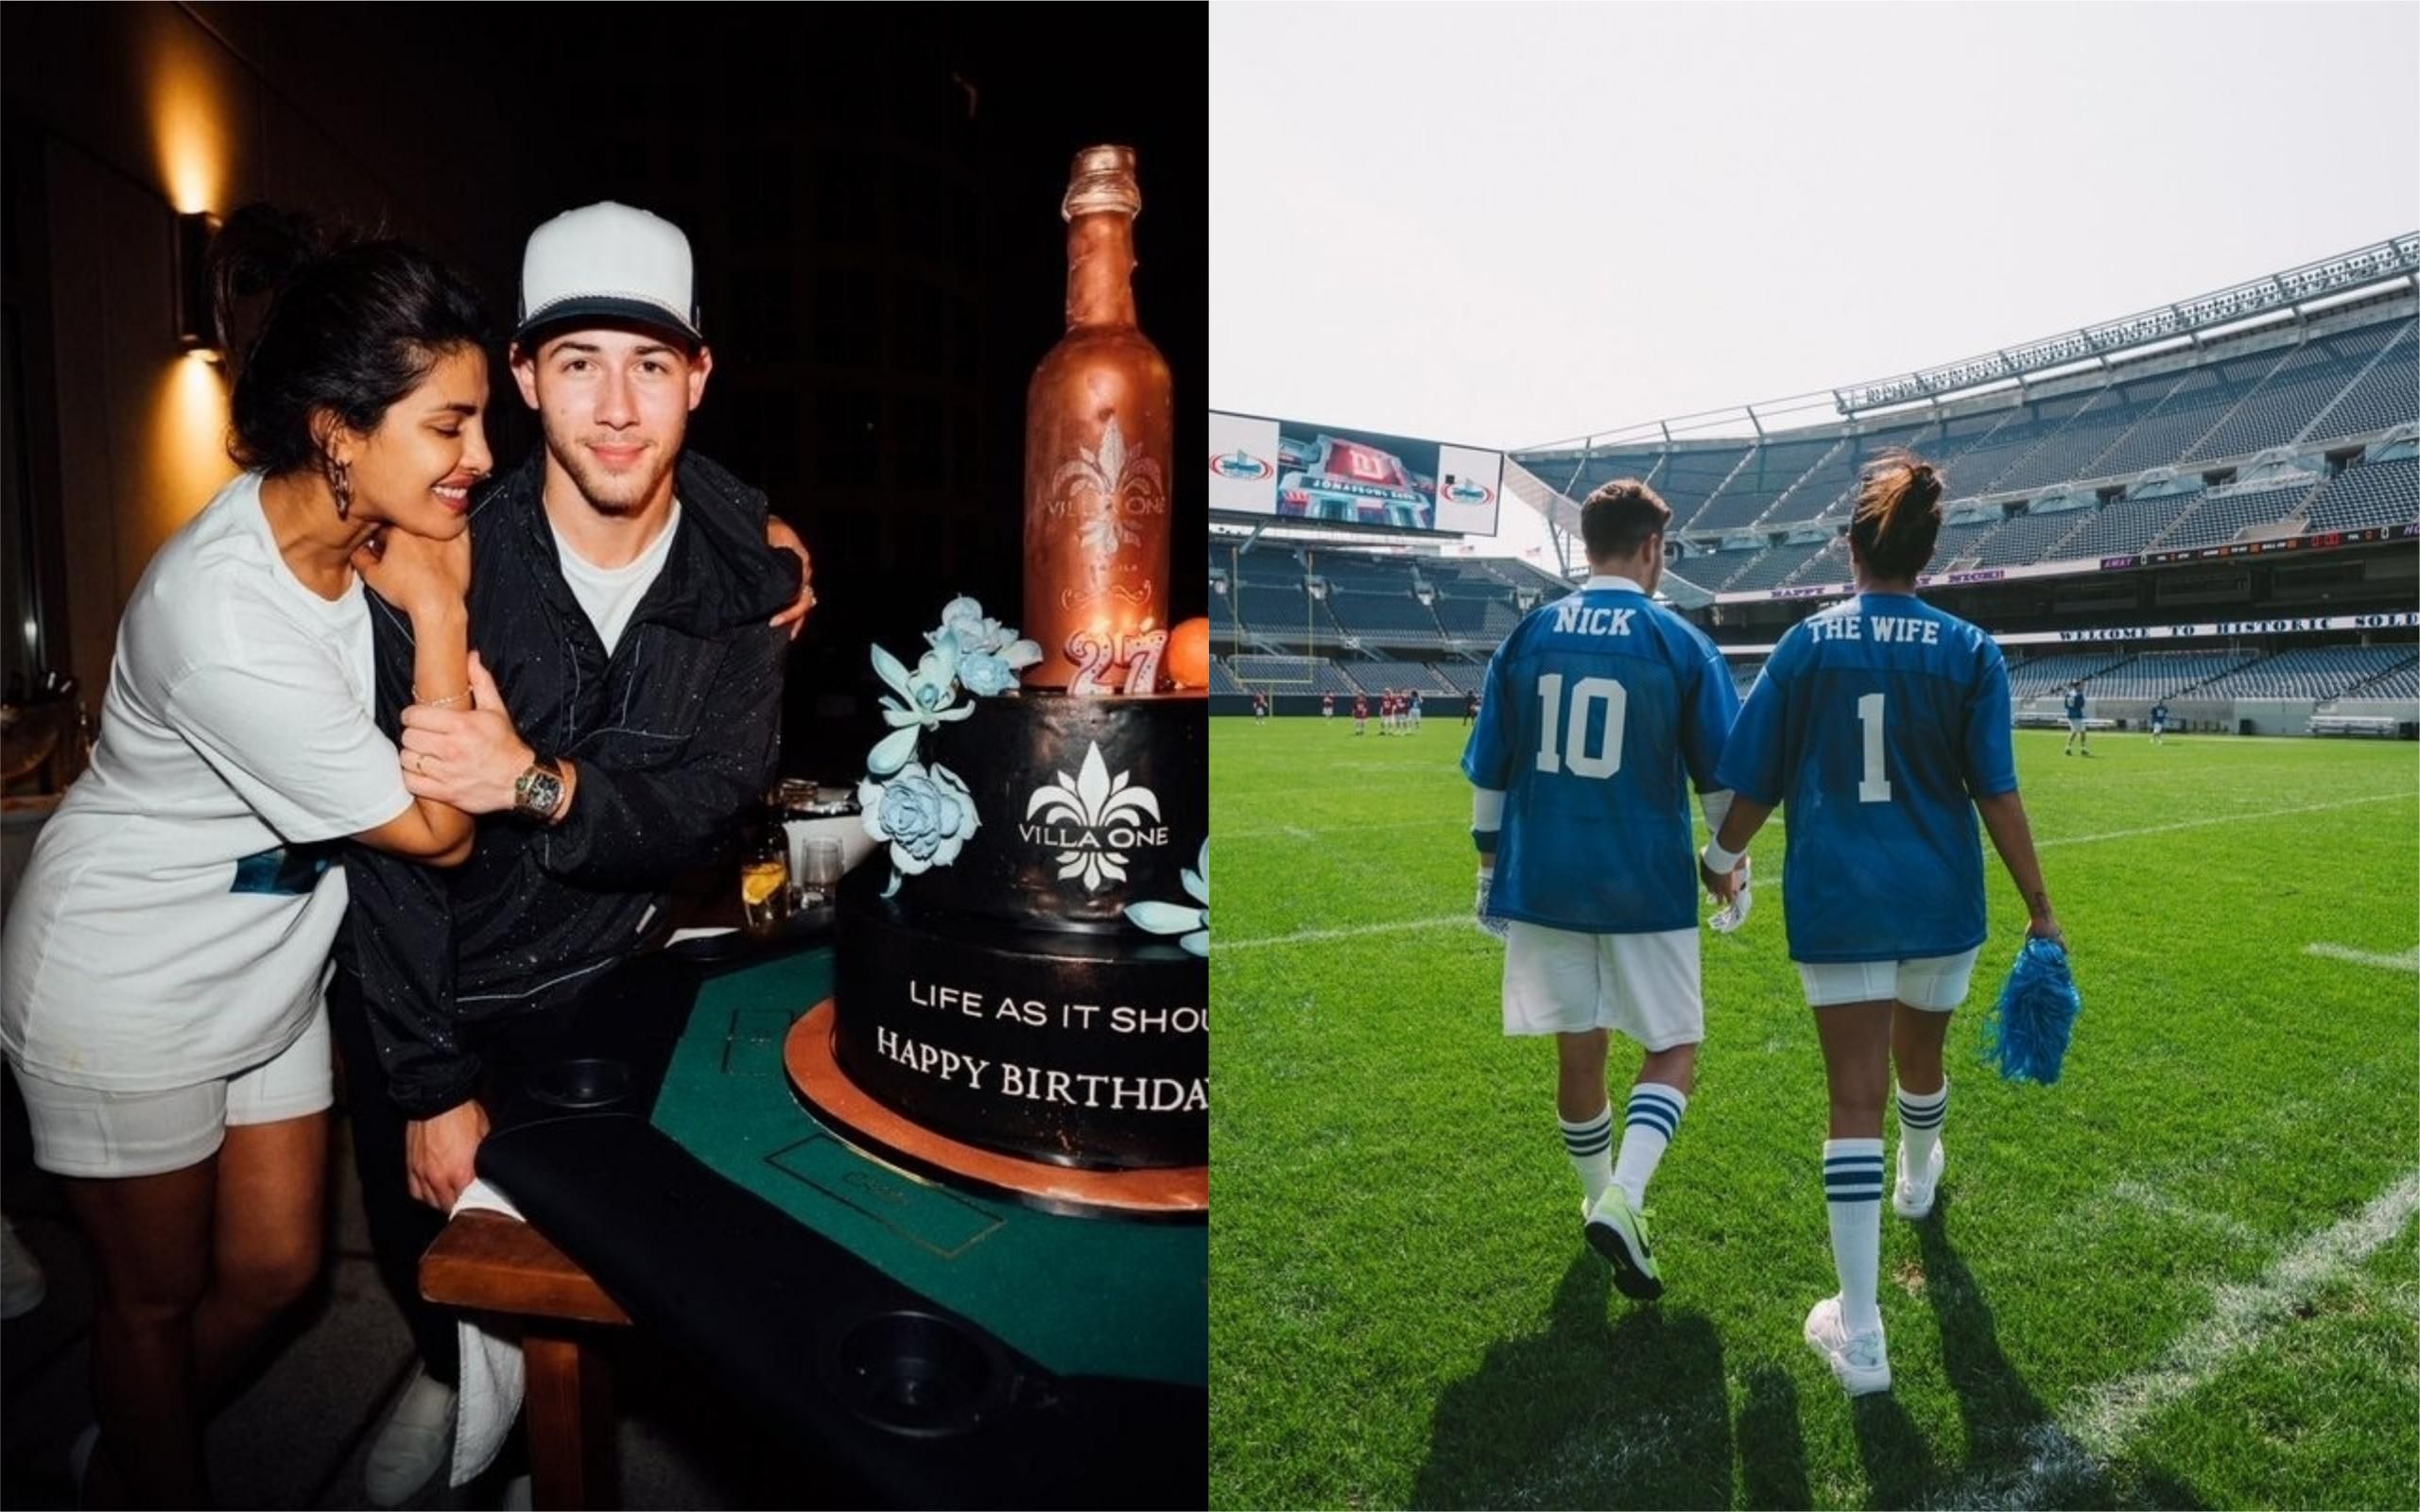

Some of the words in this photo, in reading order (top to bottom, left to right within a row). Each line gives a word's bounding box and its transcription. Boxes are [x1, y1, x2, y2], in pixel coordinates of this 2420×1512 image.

[1553, 605, 1636, 636] NICK
[1807, 616, 1861, 644] THE
[1870, 616, 1941, 644] WIFE
[2060, 627, 2152, 642] WELCOME
[2171, 626, 2195, 637] TO
[2217, 618, 2331, 634] HISTORIC
[1063, 628, 1168, 697] 27
[1536, 673, 1627, 780] 10
[1858, 693, 1892, 802] 1
[1019, 823, 1100, 848] VILLA
[1107, 826, 1169, 849] ONE
[910, 980, 983, 1018] LIFE
[995, 998, 1047, 1026] AS
[1063, 1005, 1100, 1029] IT
[877, 1025, 991, 1090] HAPPY
[1001, 1063, 1210, 1111] BIRTHDA
